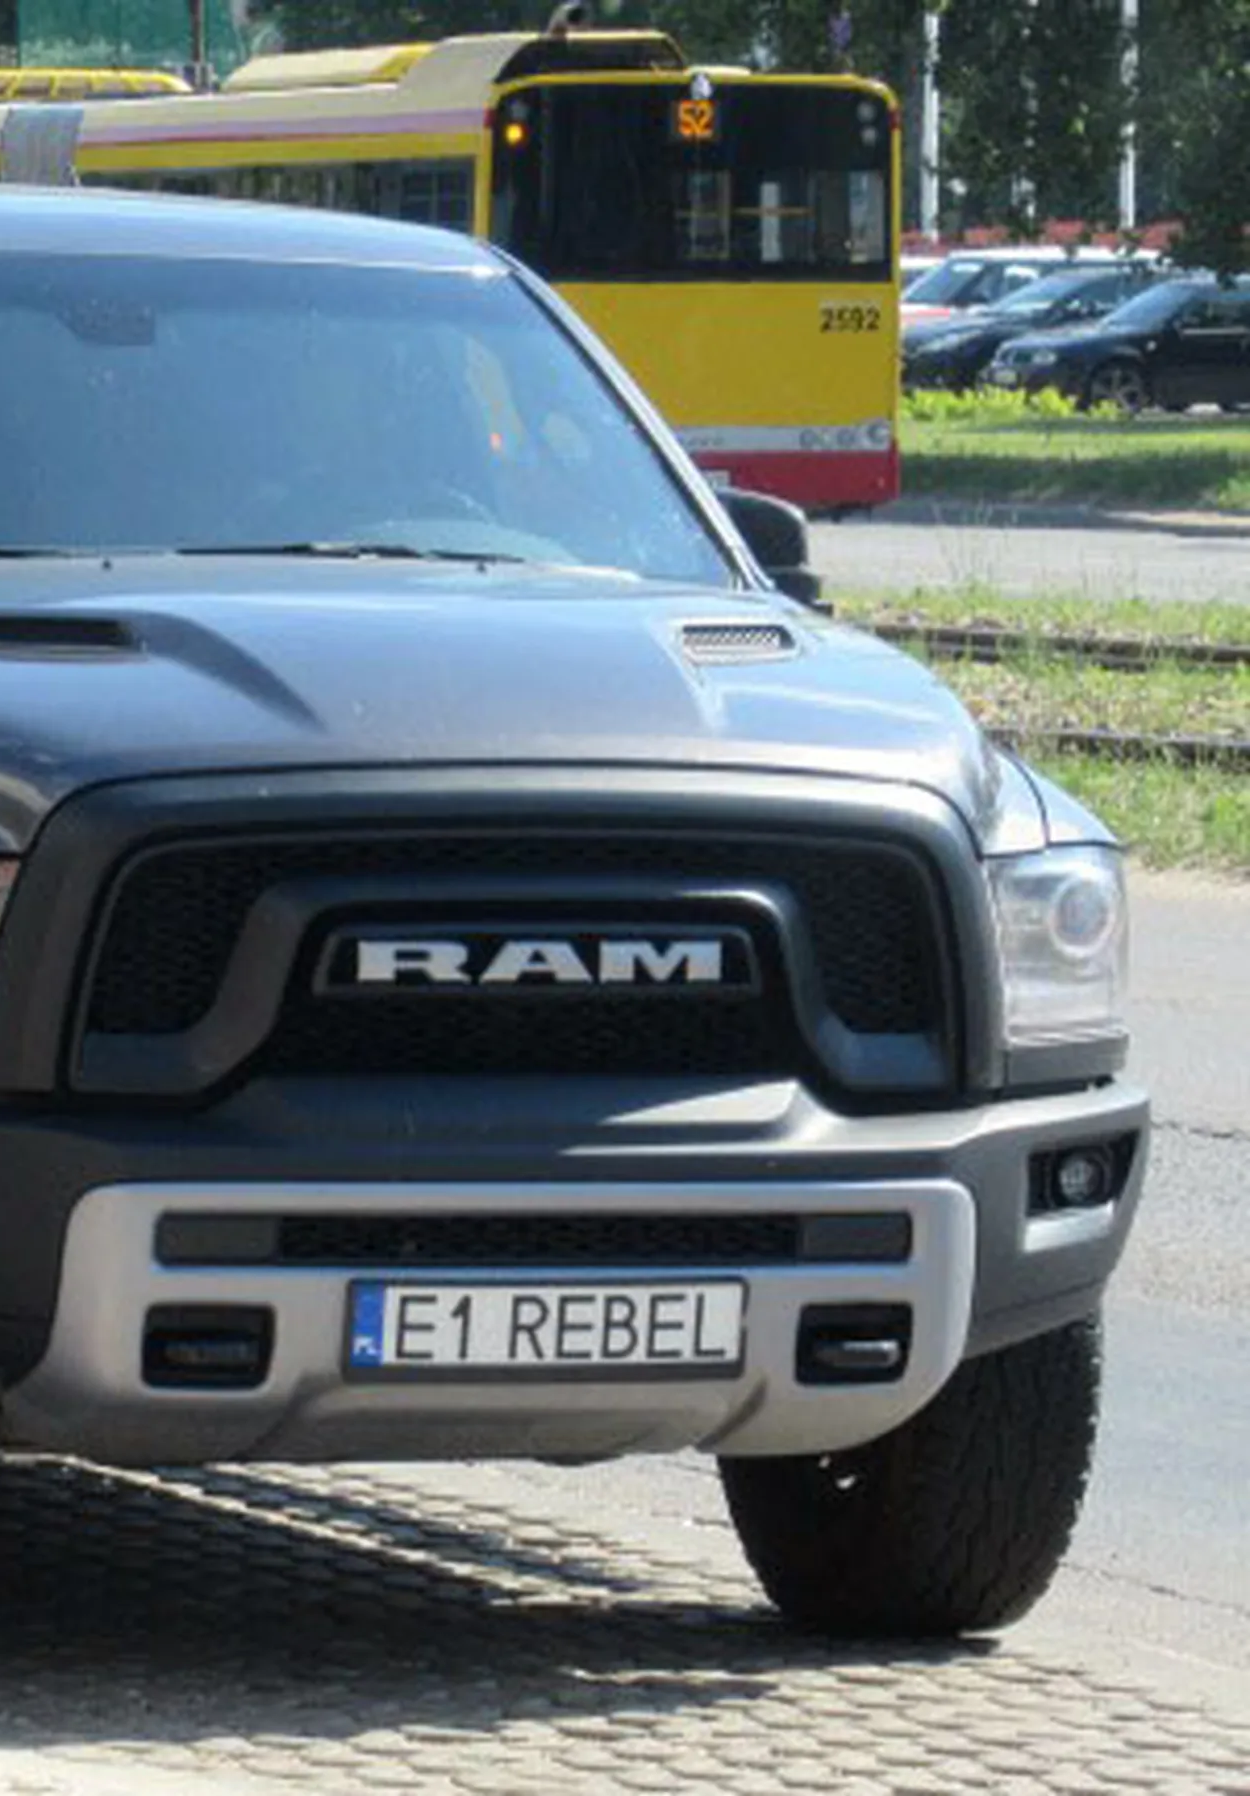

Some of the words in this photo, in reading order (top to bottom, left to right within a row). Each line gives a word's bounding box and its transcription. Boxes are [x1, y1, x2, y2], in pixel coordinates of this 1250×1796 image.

[678, 99, 714, 138] 52
[819, 305, 881, 334] 2592
[356, 939, 723, 983] RAM
[395, 1294, 472, 1360] E1
[508, 1293, 726, 1360] REBEL
